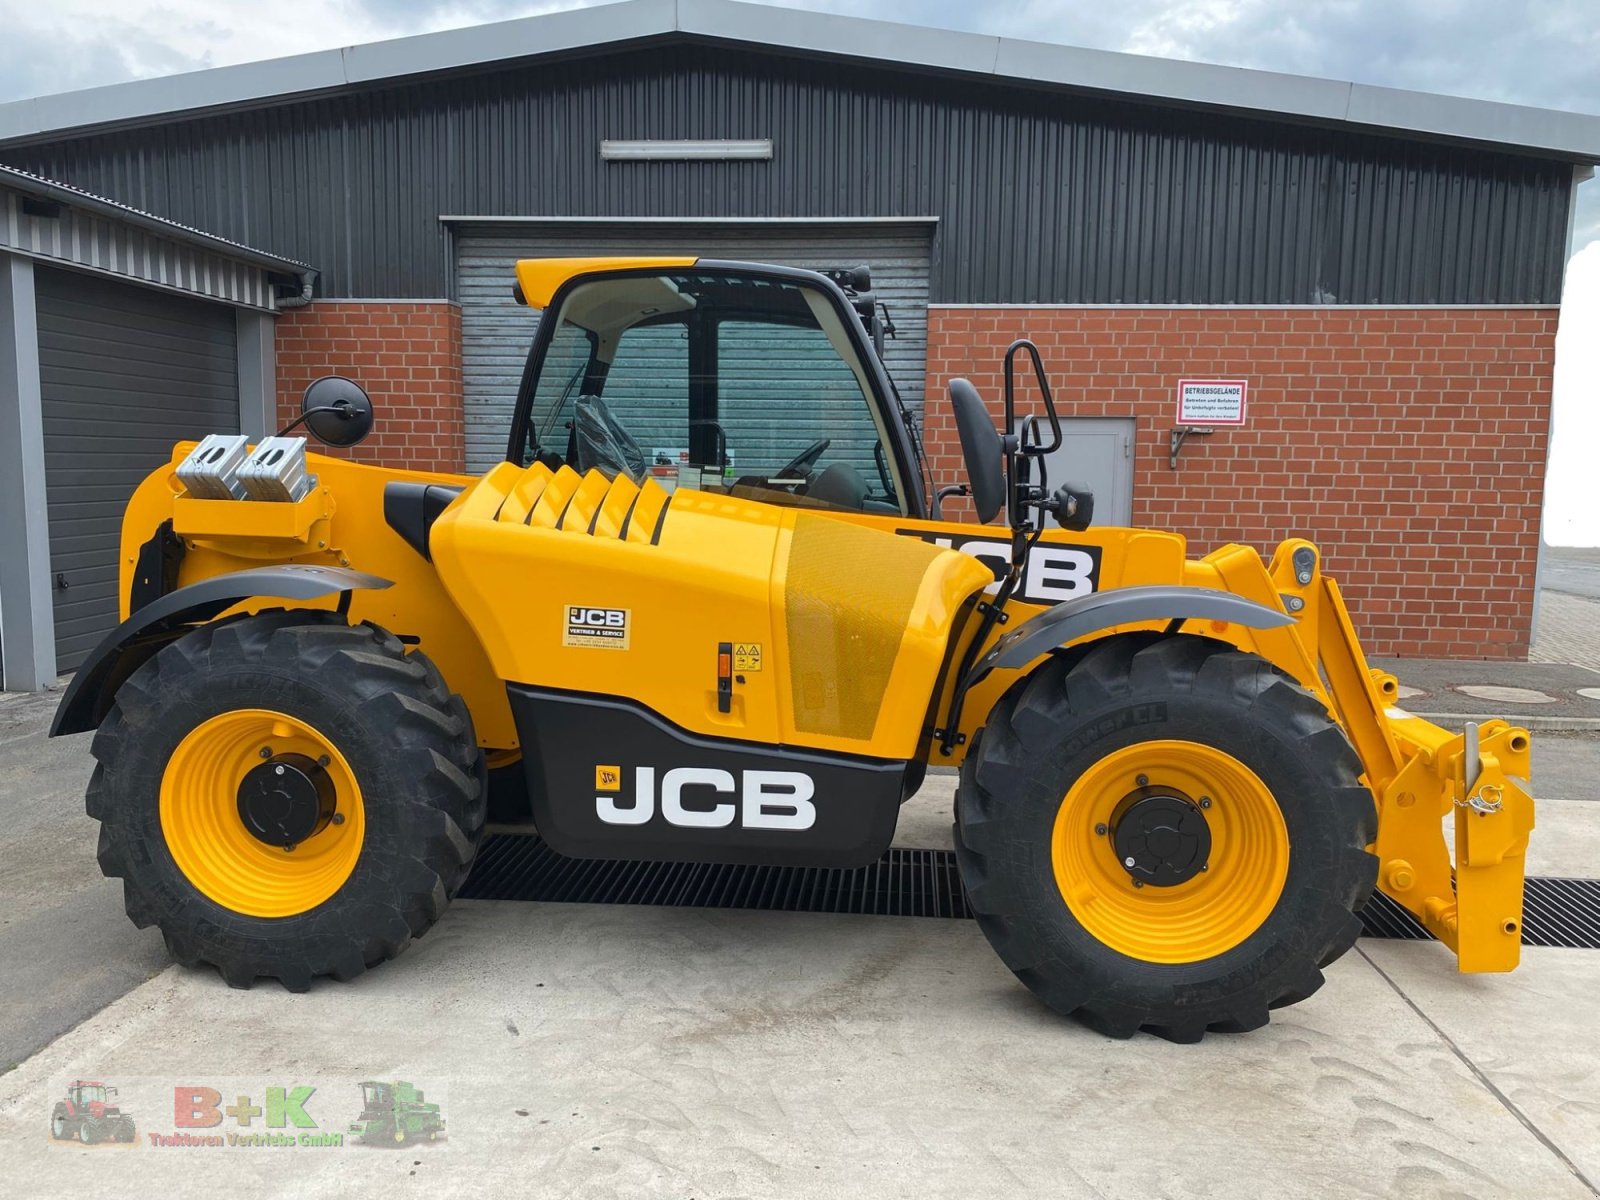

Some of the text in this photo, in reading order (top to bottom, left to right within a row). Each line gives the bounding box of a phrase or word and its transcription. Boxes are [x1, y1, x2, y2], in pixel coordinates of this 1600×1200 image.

[1185, 387, 1240, 395] BETRIEBSGELÄNDE
[570, 609, 624, 627] JCB
[595, 766, 817, 830] JCB
